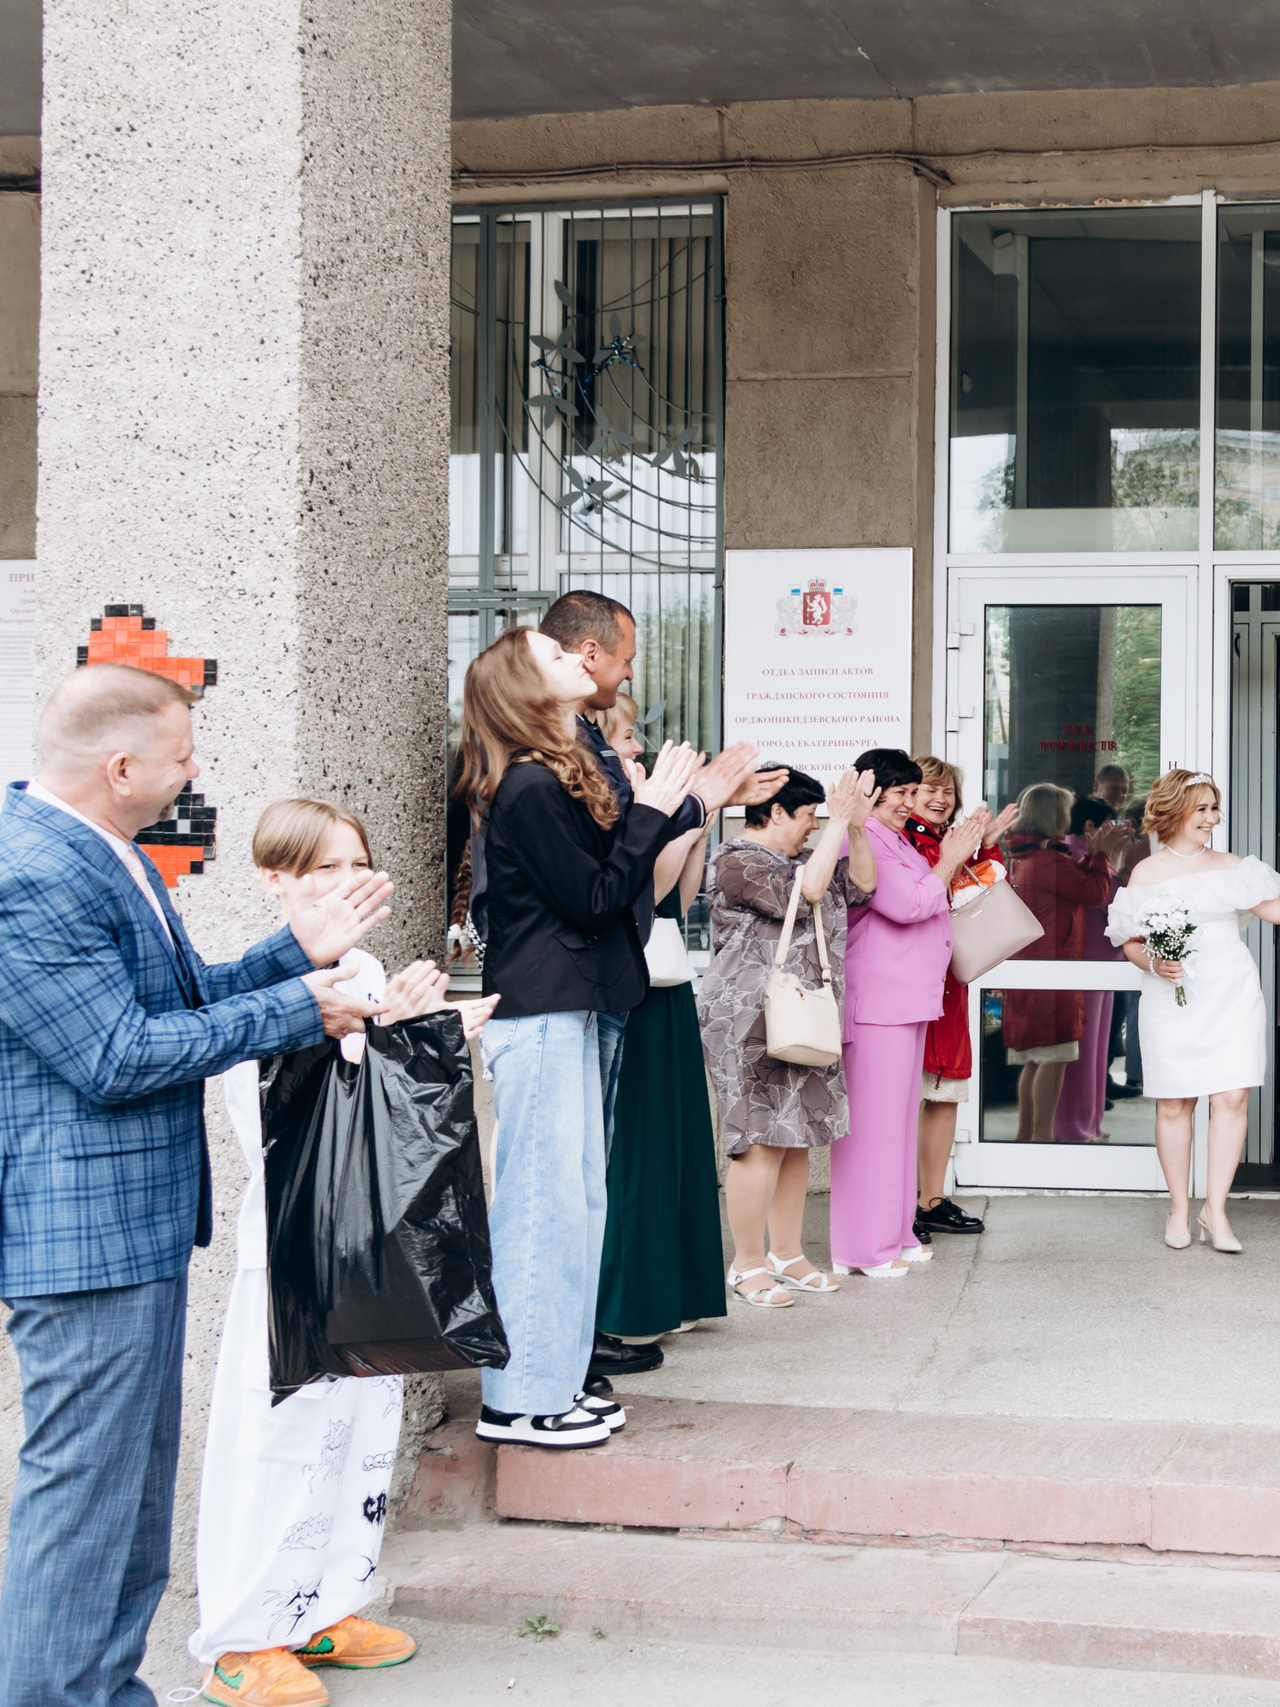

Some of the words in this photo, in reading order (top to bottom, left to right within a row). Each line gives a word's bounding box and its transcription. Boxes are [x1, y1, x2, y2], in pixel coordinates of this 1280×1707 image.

[9, 573, 35, 582] ПРИ
[762, 668, 795, 677] ОТДЕЛ
[798, 668, 838, 676] ЗАПИСИ
[746, 692, 825, 700] ГРАЖДАНСКОГО
[827, 691, 889, 699] СОСТОЯНИЯ
[735, 716, 858, 724] ОРДЖОНИКИДЗЕВСКОГО
[860, 715, 901, 723] РАЙОНА
[1062, 724, 1092, 735] ЗАЛ
[757, 740, 795, 748] ГОРОДА
[798, 739, 878, 747] ЕКАТЕРИНБУРГА
[1039, 740, 1117, 751] ТОРЖЕСТВ
